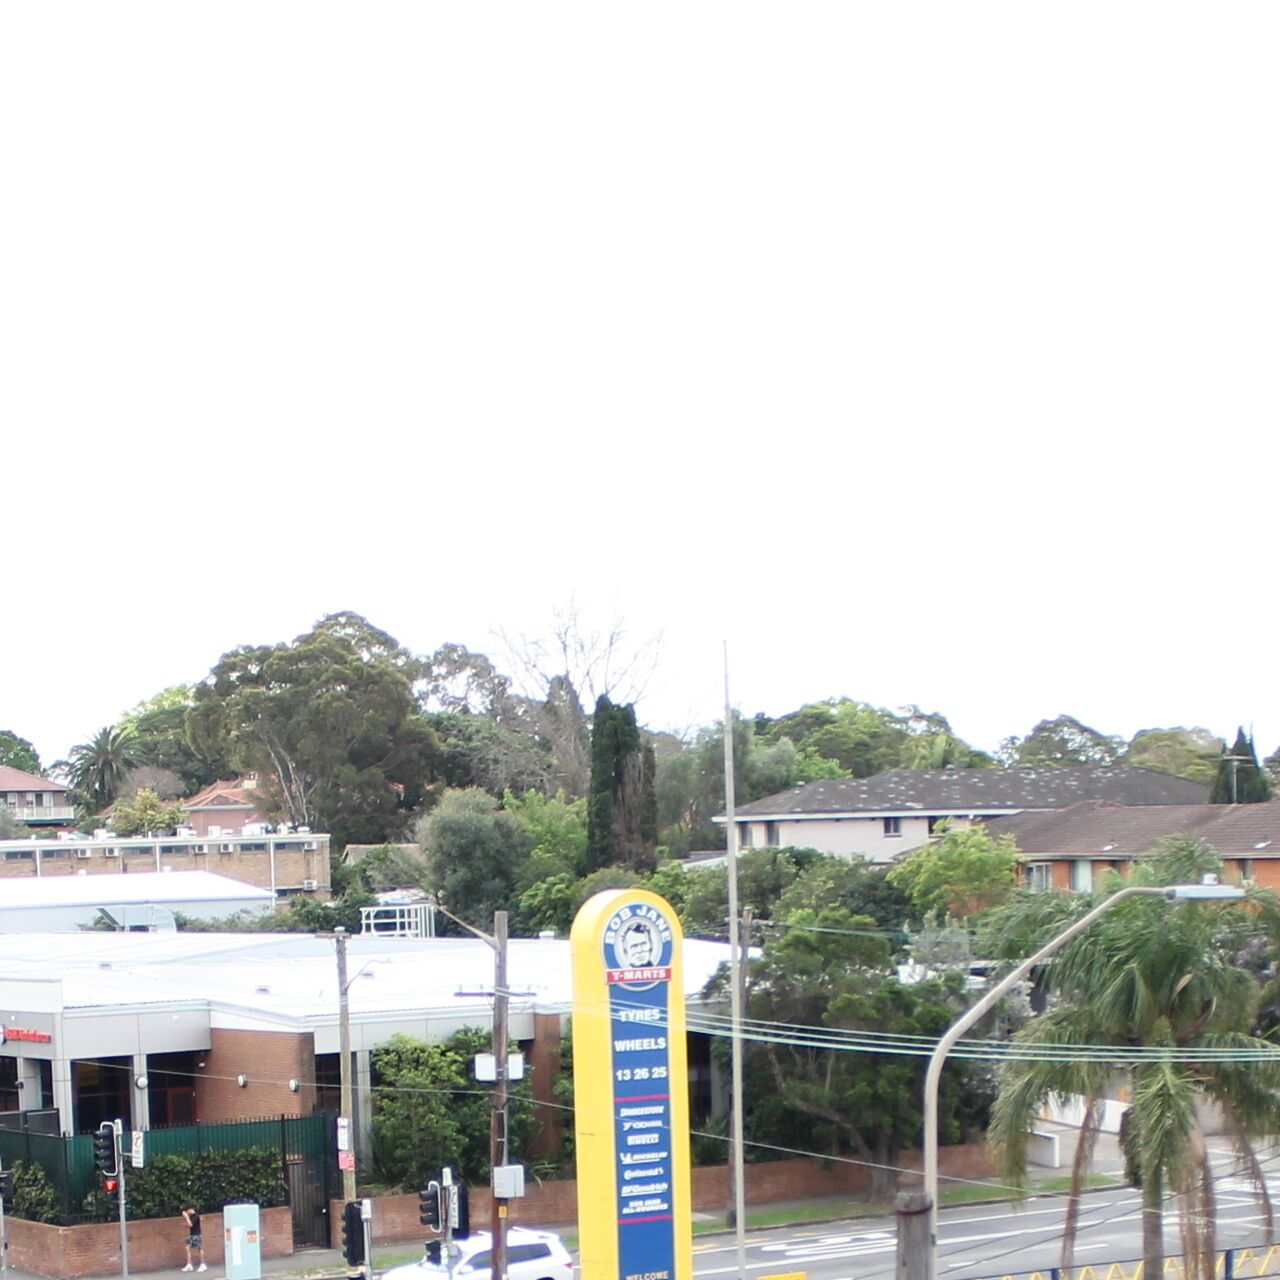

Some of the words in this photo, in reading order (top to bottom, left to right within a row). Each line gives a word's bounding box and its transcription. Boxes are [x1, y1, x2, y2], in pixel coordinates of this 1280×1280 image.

[605, 905, 632, 944] BOB
[635, 905, 672, 943] JANE
[612, 968, 666, 981] T-MARTS
[619, 1008, 660, 1022] TYRES
[614, 1037, 667, 1052] WHEELS
[616, 1069, 631, 1081] 13
[634, 1068, 649, 1080] 26
[652, 1067, 667, 1079] 25
